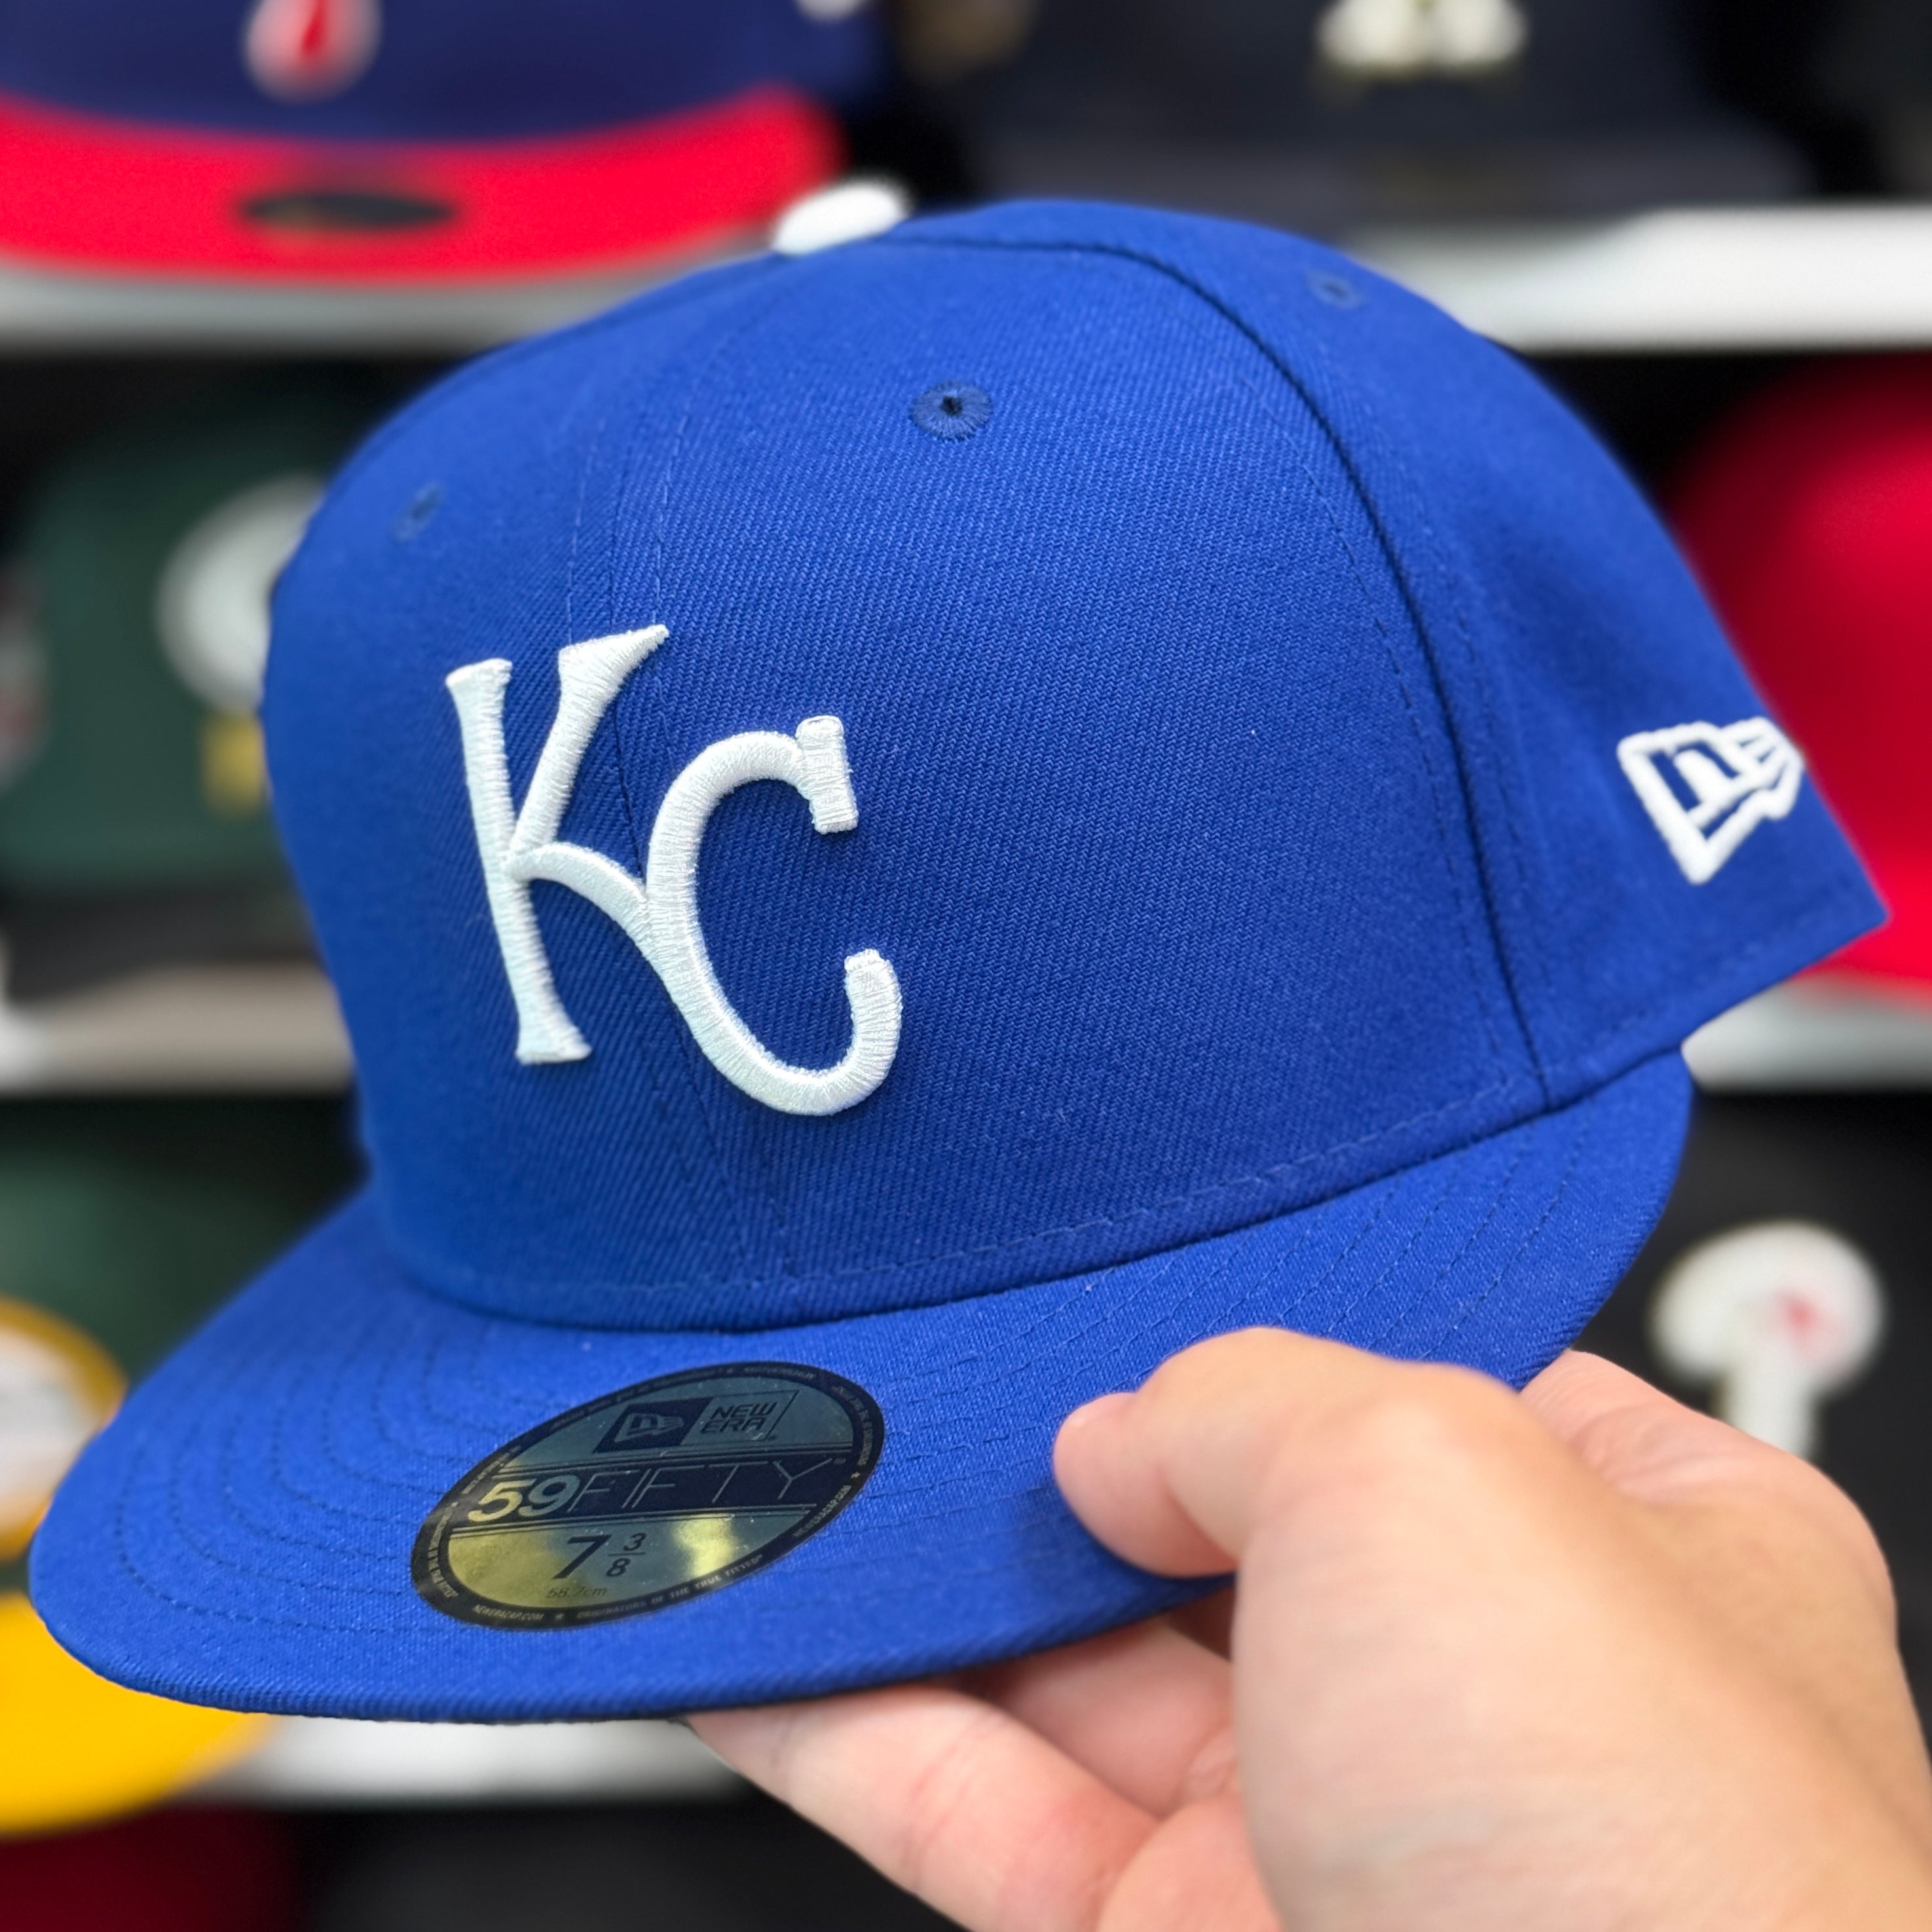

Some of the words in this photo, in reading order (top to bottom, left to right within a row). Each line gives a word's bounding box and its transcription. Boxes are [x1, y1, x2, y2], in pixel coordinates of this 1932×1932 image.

[446, 624, 902, 1115] KC
[710, 1401, 777, 1419] NEW
[700, 1417, 766, 1434] ERA
[551, 1534, 612, 1580] 7
[669, 1587, 690, 1599] THE
[694, 1574, 722, 1589] TRUE
